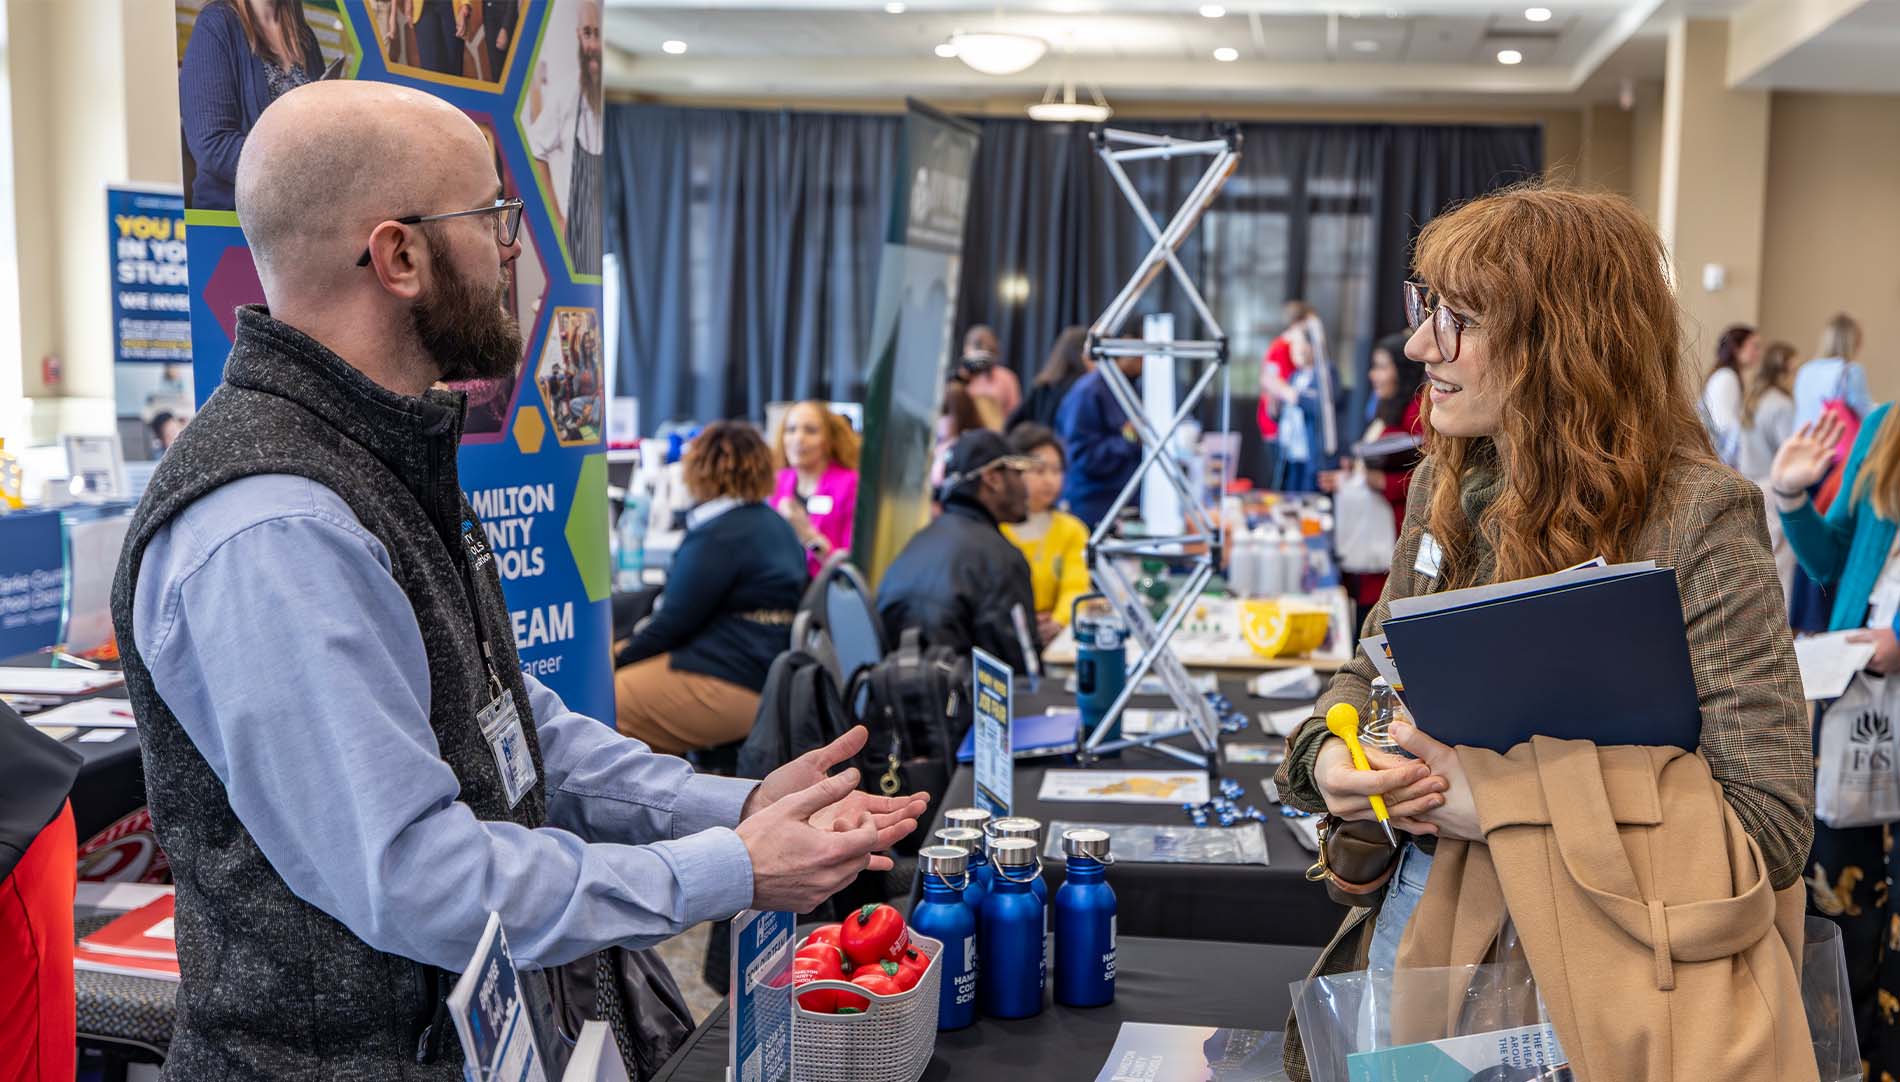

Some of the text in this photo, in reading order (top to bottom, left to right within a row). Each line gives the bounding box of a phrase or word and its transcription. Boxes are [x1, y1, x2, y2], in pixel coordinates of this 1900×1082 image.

[116, 215, 171, 240] YOU
[149, 240, 187, 264] YO
[508, 601, 574, 650] EAM
[519, 655, 562, 676] areer
[1499, 1038, 1508, 1055] THE
[1521, 1034, 1530, 1044] IN
[1533, 1032, 1543, 1049] THE
